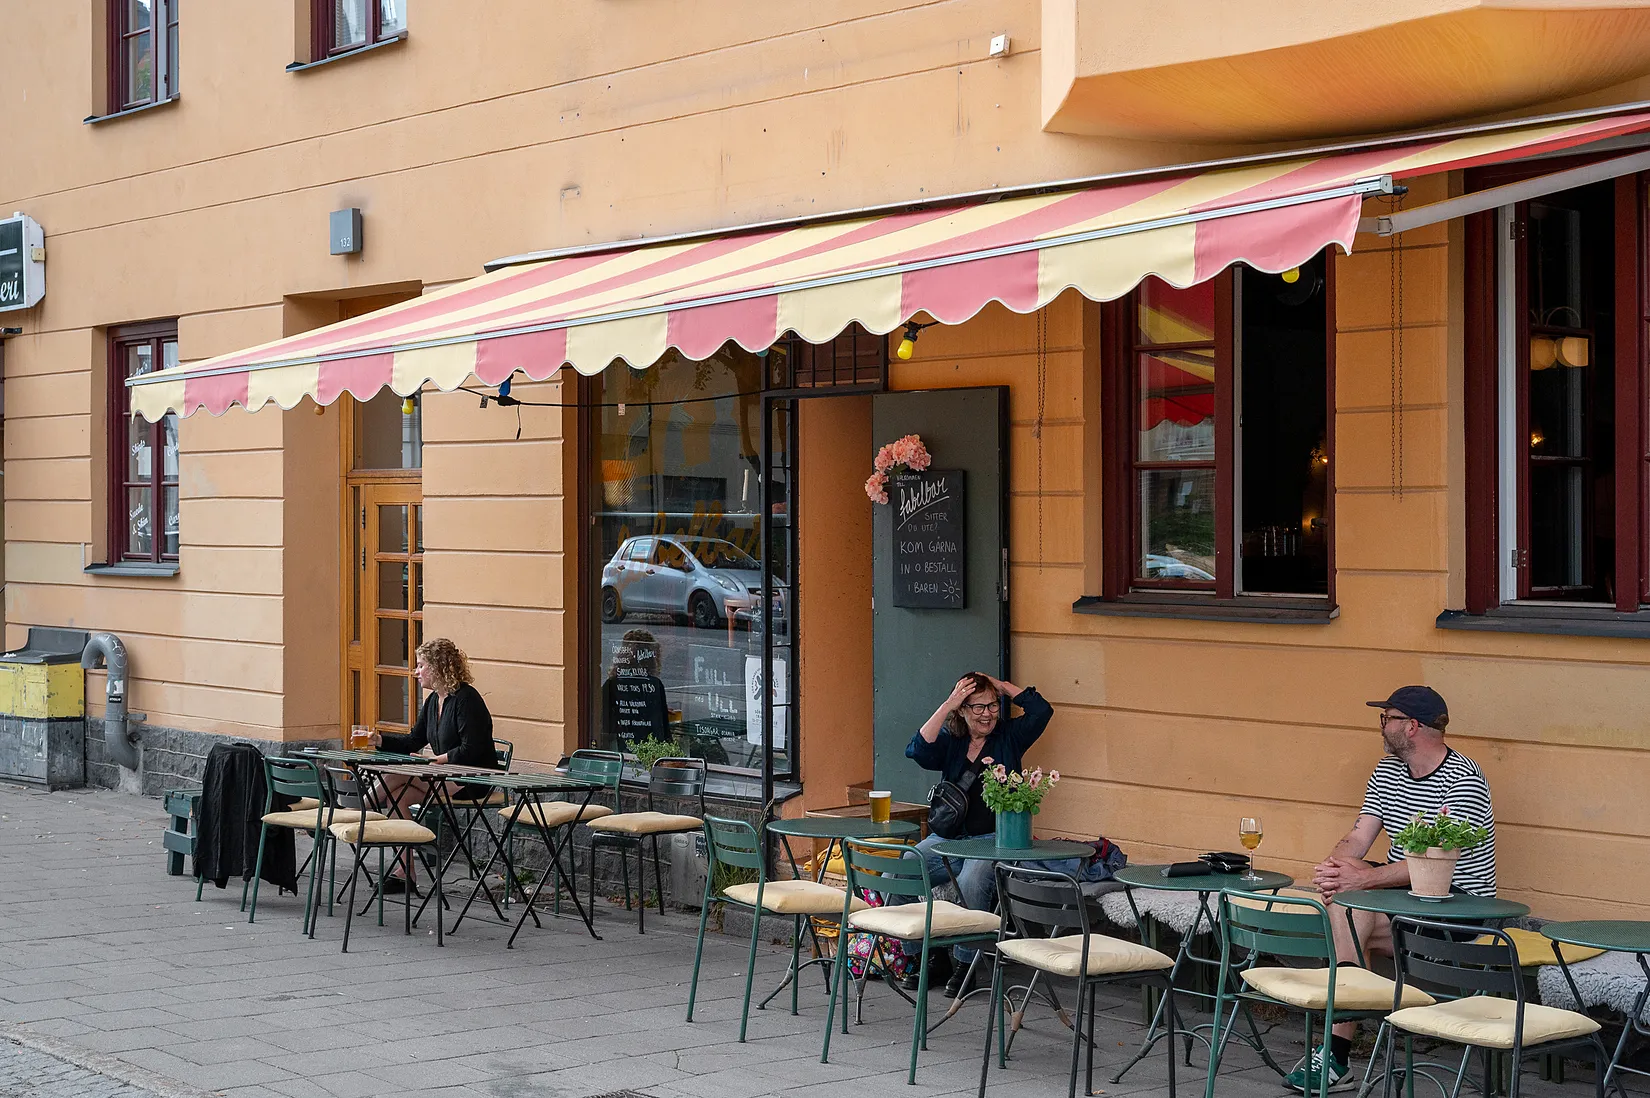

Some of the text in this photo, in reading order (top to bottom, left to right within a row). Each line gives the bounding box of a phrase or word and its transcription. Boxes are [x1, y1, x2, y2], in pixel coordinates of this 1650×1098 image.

[340, 237, 350, 248] 132
[899, 477, 949, 522] fabelbar
[924, 512, 949, 523] SITTER
[900, 541, 924, 554] KOM
[900, 563, 911, 575] IN
[914, 581, 940, 594] BAREN
[694, 656, 731, 686] FULL
[707, 692, 738, 714] ULL
